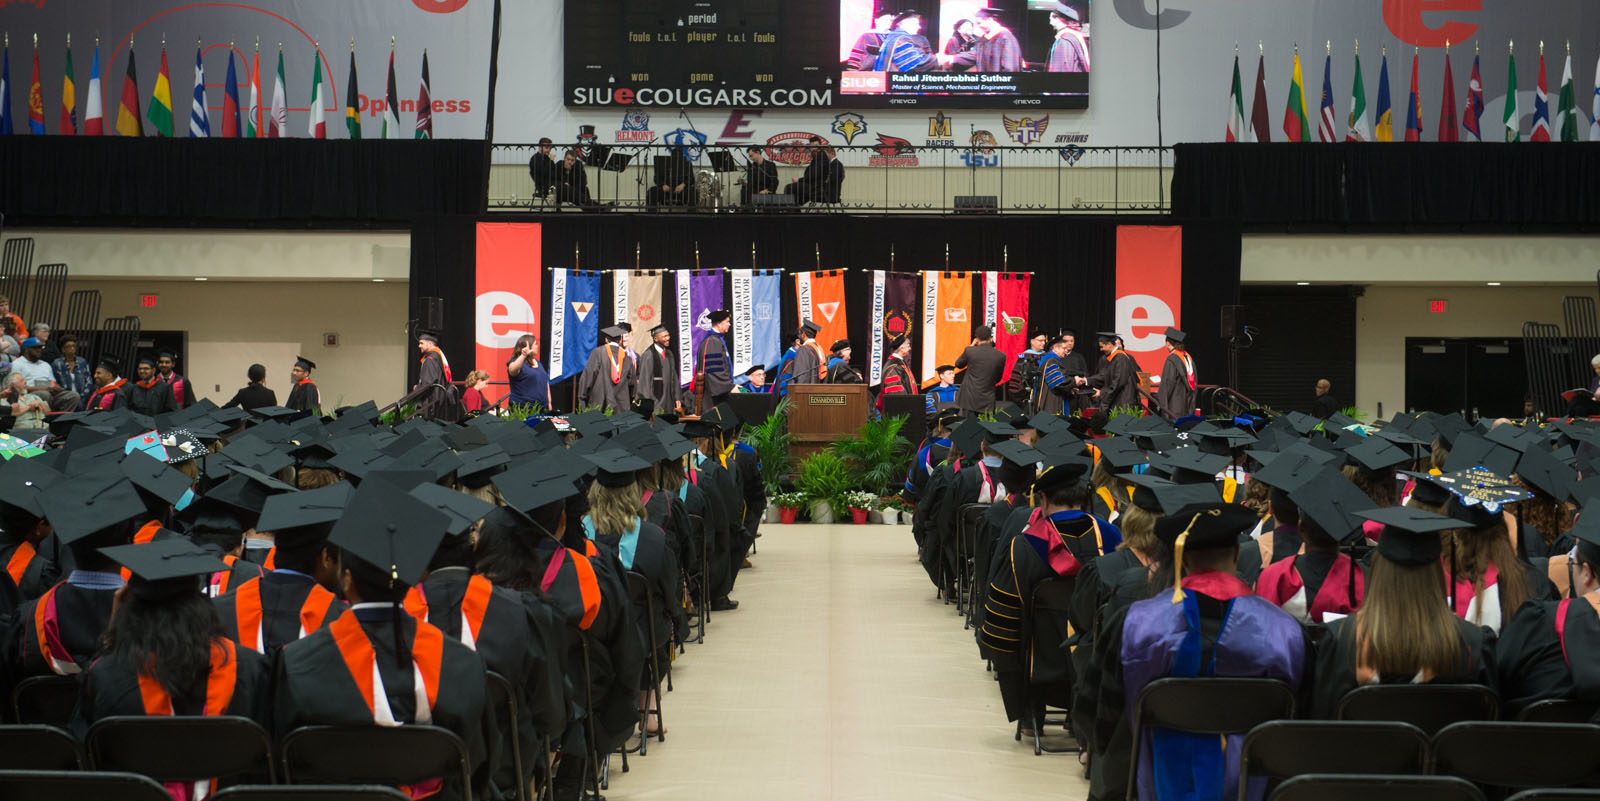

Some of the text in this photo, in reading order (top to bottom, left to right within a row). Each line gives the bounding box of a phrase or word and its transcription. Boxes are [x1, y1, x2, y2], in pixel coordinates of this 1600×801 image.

[688, 12, 717, 26] period
[629, 32, 650, 42] fouls
[688, 31, 717, 43] player
[754, 32, 775, 43] fouls
[631, 72, 773, 83] won game won
[358, 94, 471, 117] Opness
[574, 88, 832, 106] SIUeCOUGARS.COM
[616, 130, 654, 141] BELMONT
[1054, 134, 1088, 143] SKYHAWKS
[142, 296, 156, 307] EXIT
[554, 279, 564, 326] SCIENCES
[618, 280, 627, 324] USINESS
[734, 278, 742, 312] HEALTH
[743, 278, 751, 321] BEHAVIOR
[926, 281, 936, 324] NURSING
[1432, 301, 1446, 312] EXIT
[476, 291, 535, 349] e
[680, 284, 691, 372] DENTAL MEDICINE
[872, 282, 883, 380] GRADUATE SCHOOL
[1116, 294, 1174, 352] e
[553, 339, 561, 365] ARTS
[1466, 474, 1509, 485] DIPLOMAS
